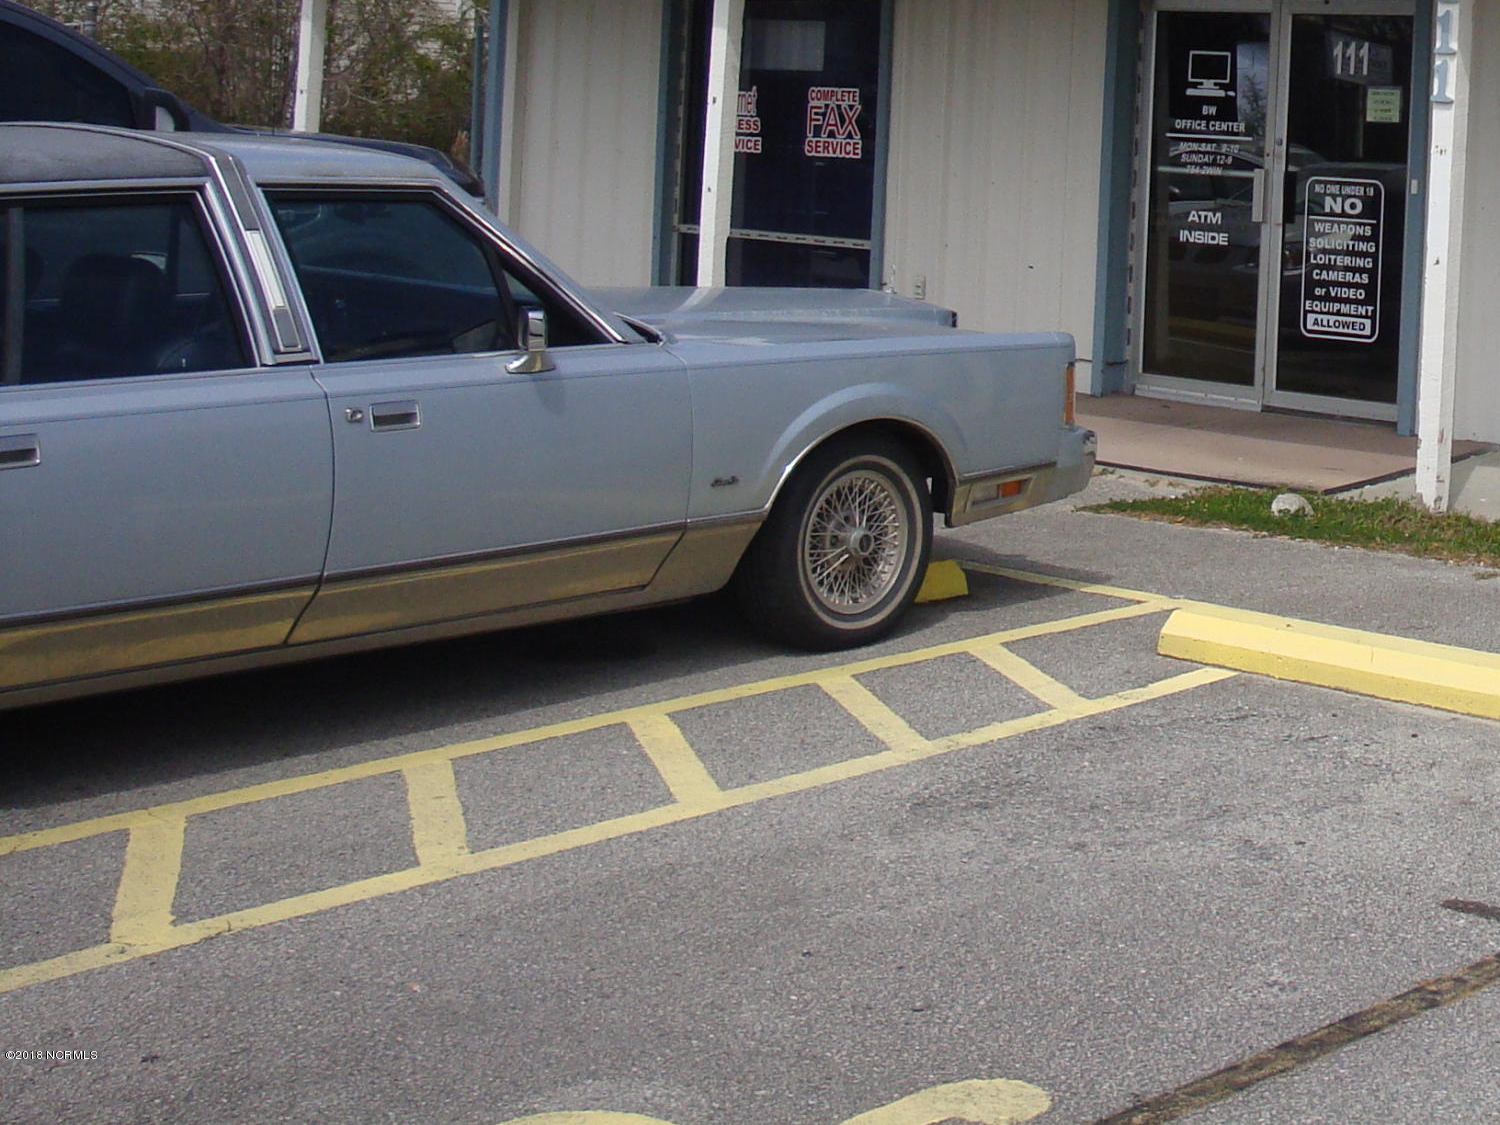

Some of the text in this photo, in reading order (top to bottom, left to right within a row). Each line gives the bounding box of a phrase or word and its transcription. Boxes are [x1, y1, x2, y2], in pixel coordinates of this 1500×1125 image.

[1333, 41, 1369, 75] 111
[808, 87, 859, 104] COMPLETE
[1202, 105, 1217, 116] BW
[736, 117, 760, 133] ESS
[806, 103, 862, 139] FAX
[1175, 119, 1246, 132] OFFICE CENTER
[734, 136, 762, 154] VICE
[805, 137, 862, 159] SERVICE
[1180, 153, 1215, 164] SUNDAY
[1314, 183, 1325, 193] NO
[1326, 184, 1340, 195] ONE
[1341, 185, 1365, 196] UNDER
[1324, 196, 1363, 215] NO
[1187, 210, 1222, 225] ATM
[1314, 221, 1372, 236] WEAPONS
[1179, 229, 1229, 245] INSIDE
[1308, 236, 1376, 252] SOLICITING
[1310, 253, 1373, 268] LOITERING
[1312, 269, 1369, 284] CAMERAS
[1314, 286, 1366, 300] or VIDEO
[1305, 300, 1374, 317] EQUIPMENT
[1312, 317, 1366, 332] ALLOWED
